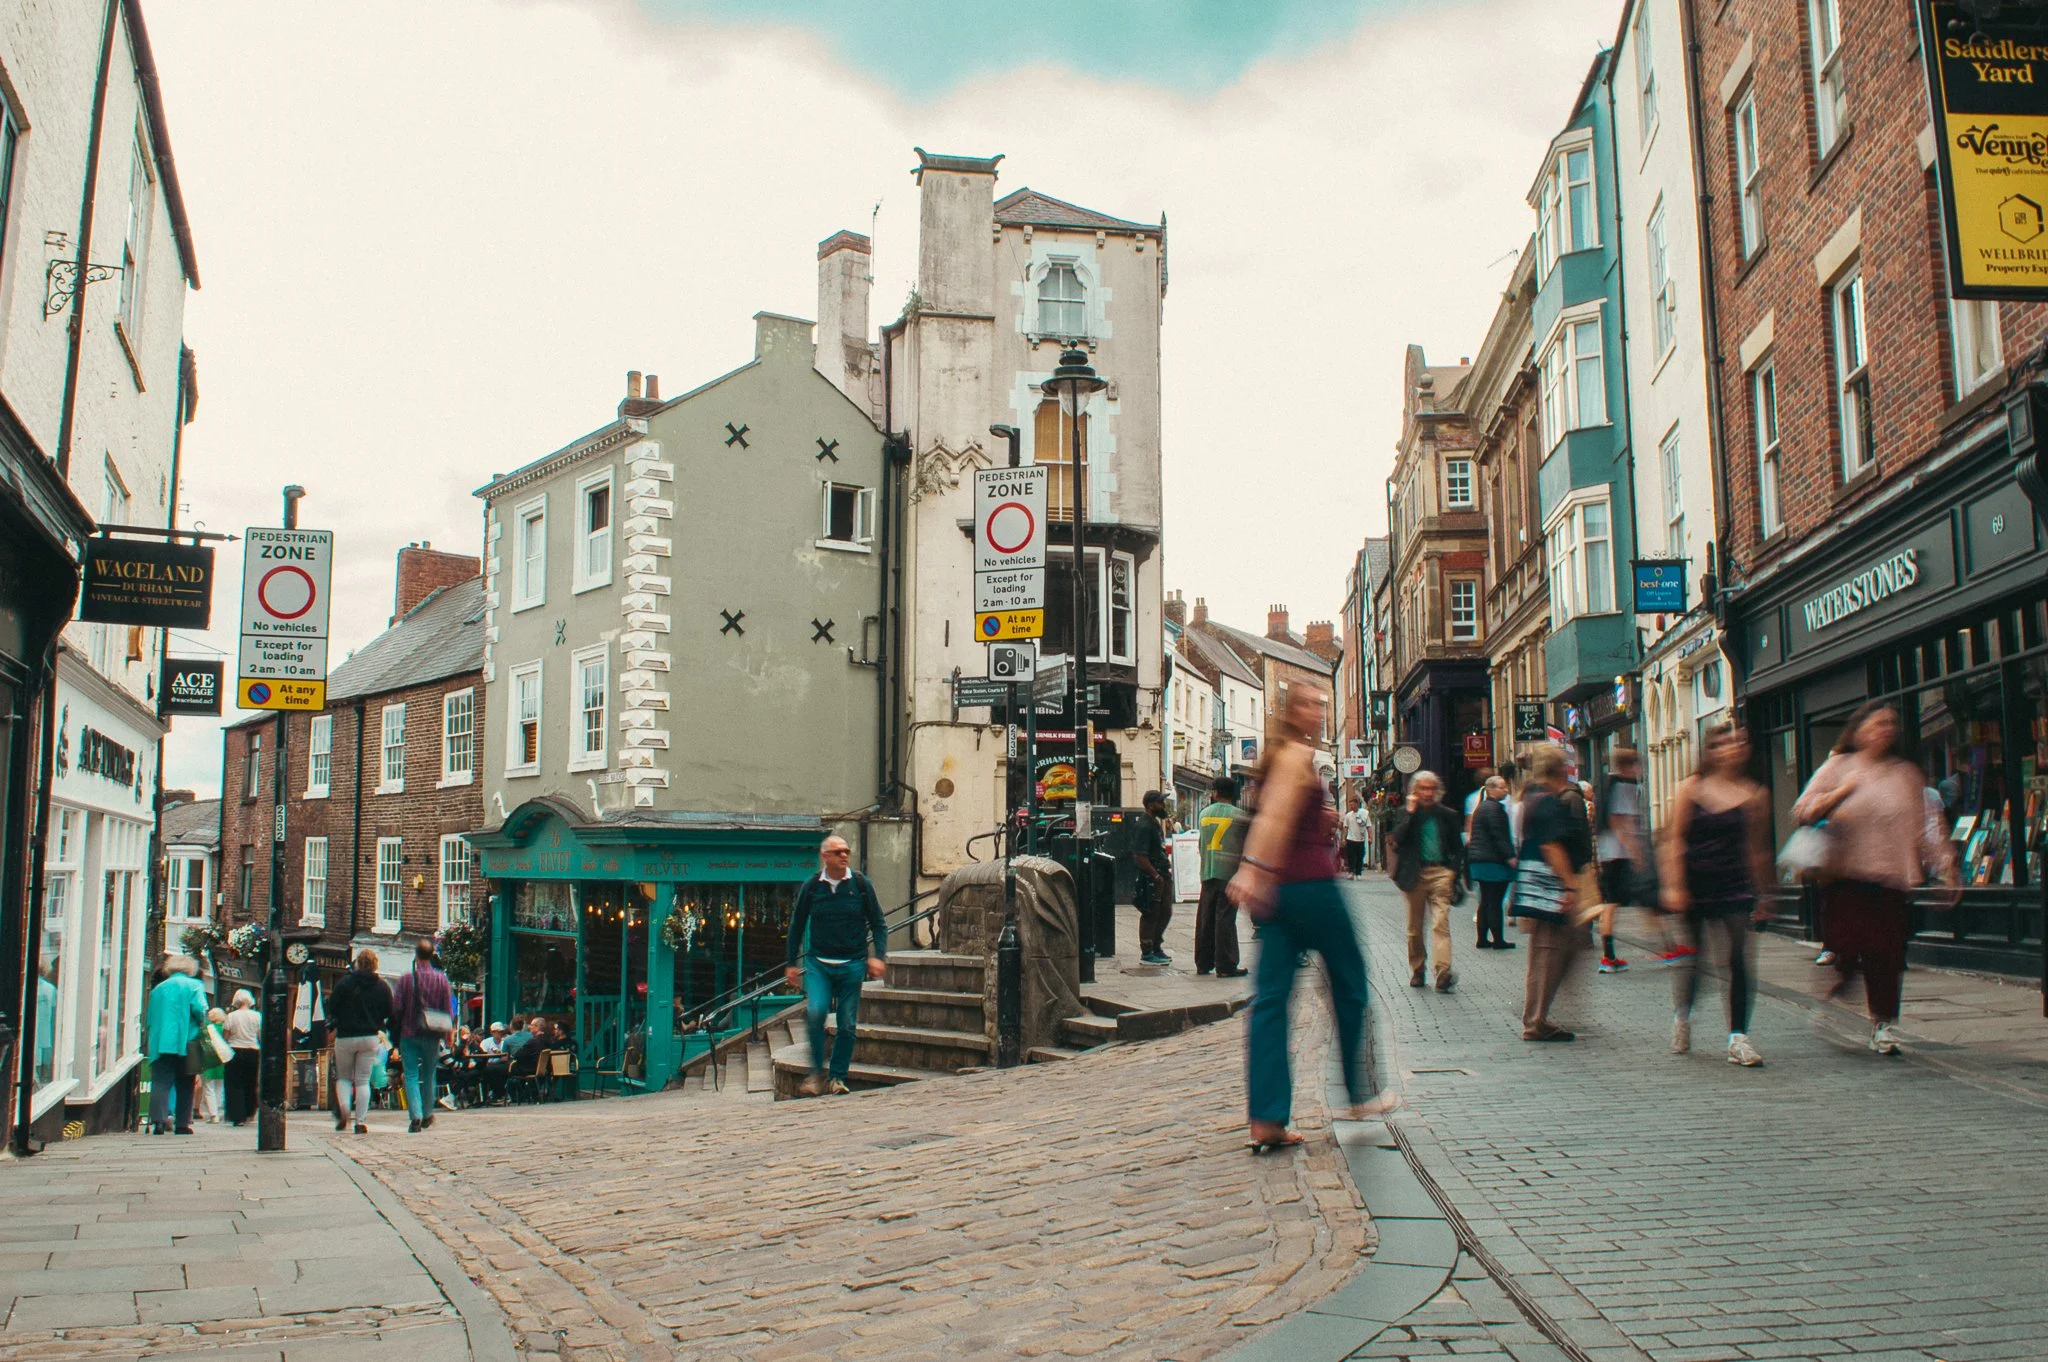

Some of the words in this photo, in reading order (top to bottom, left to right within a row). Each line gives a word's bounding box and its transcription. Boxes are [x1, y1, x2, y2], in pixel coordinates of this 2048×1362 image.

[1945, 38, 2048, 61] Saddlers
[1972, 61, 2034, 83] Yard
[1957, 123, 2048, 165] Venne
[1986, 264, 2030, 274] Property
[979, 470, 1044, 482] PEDESTRIAN
[988, 482, 1033, 498] ZONE
[1992, 514, 2004, 535] 69
[251, 532, 328, 544] PEDESTRIAN
[261, 545, 316, 561] ZONE
[984, 558, 997, 567] No
[1000, 556, 1037, 566] vehicles
[95, 559, 205, 583] WACELAND
[986, 574, 1017, 583] Except
[1020, 573, 1033, 581] for
[1640, 580, 1679, 588] best-one
[122, 582, 172, 594] DURHAM
[993, 584, 1026, 594] loading
[1804, 548, 1918, 632] WATERSTONES
[90, 592, 129, 603] VINTAGE
[141, 597, 202, 608] STREETWEAR
[983, 598, 989, 607] 2
[1010, 597, 1021, 605] 10
[1022, 597, 1036, 605] am
[1007, 615, 1018, 624] At
[1020, 615, 1037, 624] any
[253, 622, 269, 631] No
[273, 623, 318, 633] vehicles
[1011, 626, 1032, 634] time
[255, 640, 294, 651] Except
[297, 642, 313, 651] for
[263, 651, 304, 662] loading
[249, 664, 257, 673] 2
[259, 666, 276, 674] am
[284, 666, 297, 674] 10
[171, 671, 215, 688] ACE
[171, 687, 214, 696] VINTAGE
[280, 684, 293, 694] At
[296, 687, 316, 696] any
[285, 696, 310, 704] time
[1201, 816, 1233, 851] 7
[540, 851, 572, 871] ELVET
[643, 862, 689, 876] ELVET
